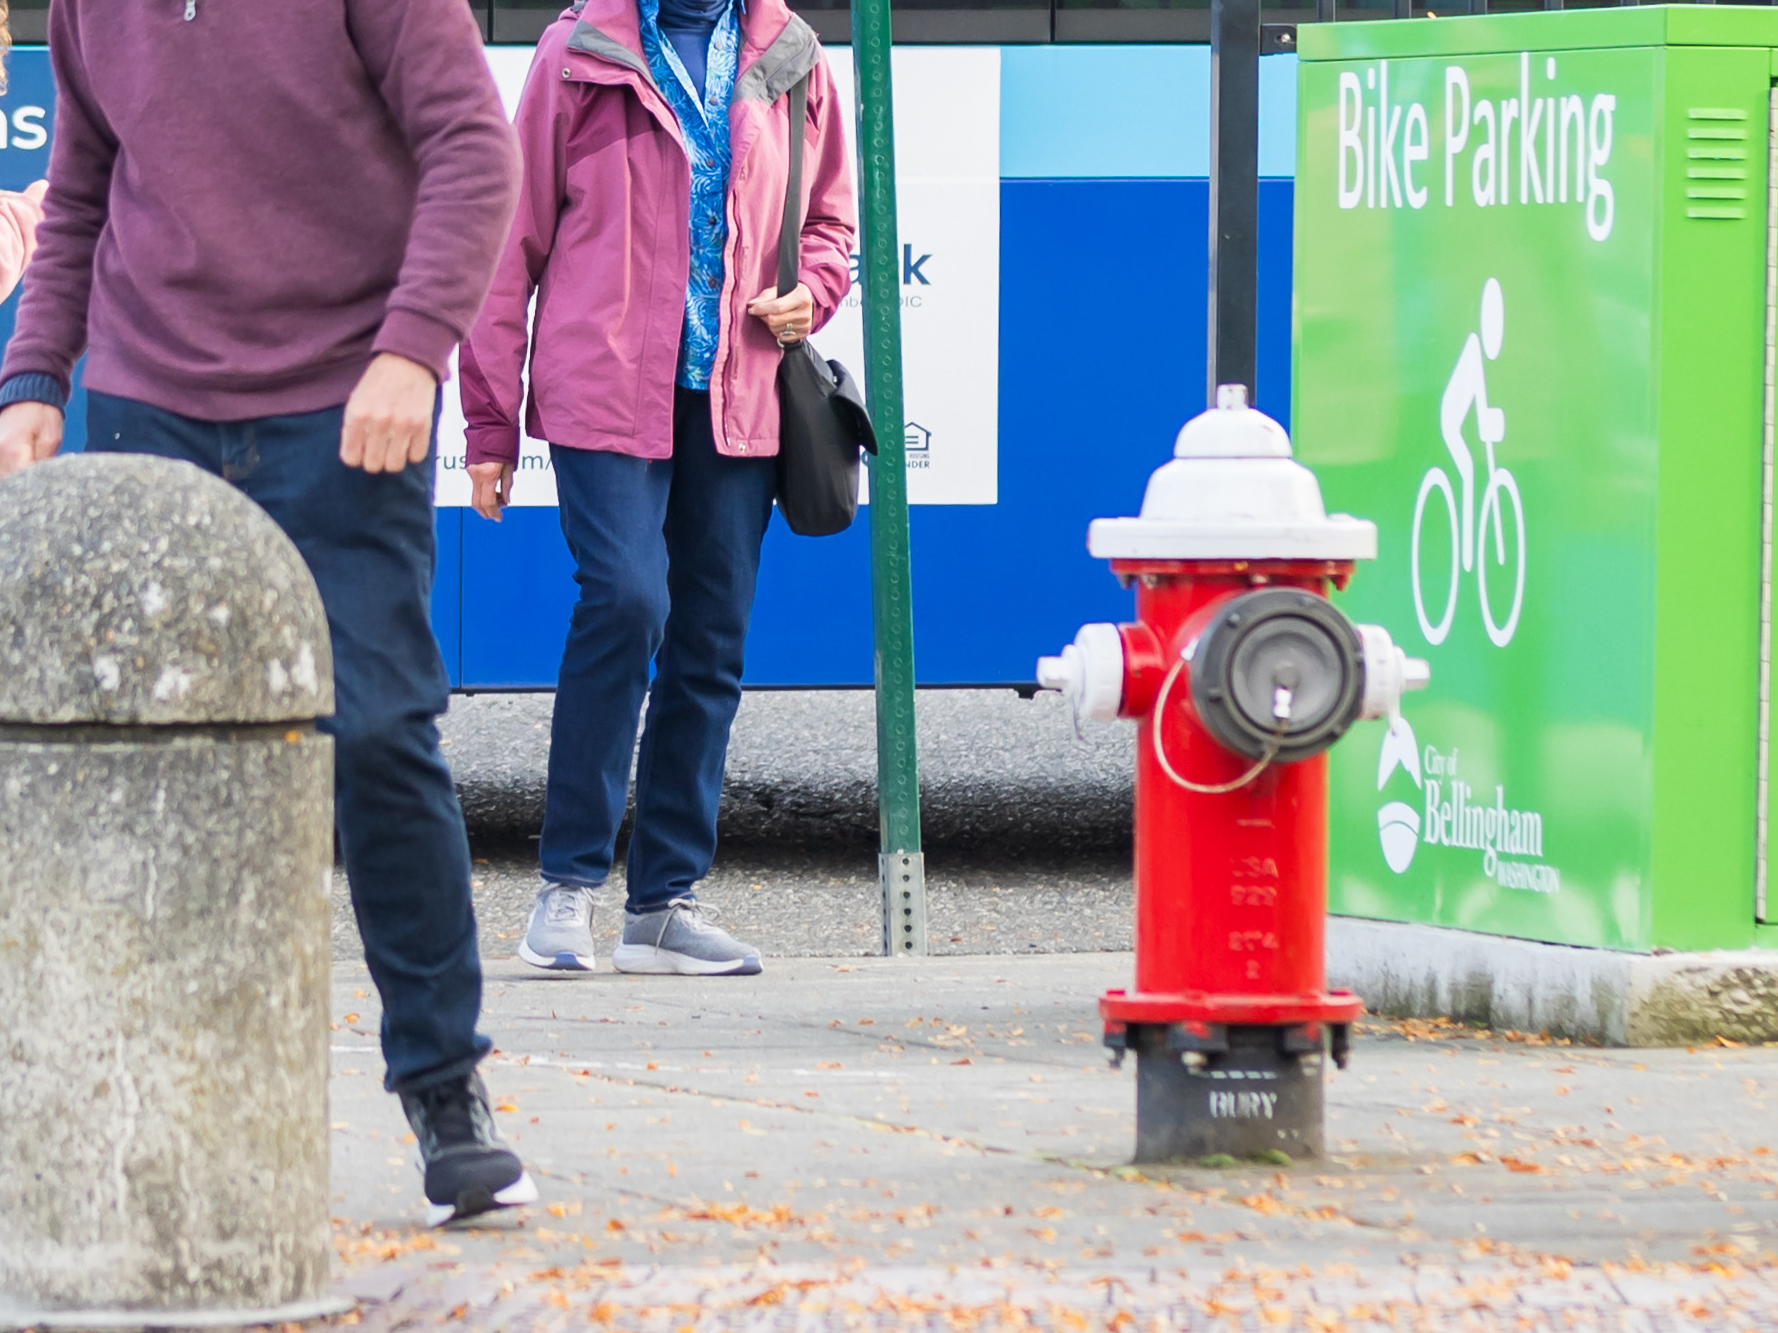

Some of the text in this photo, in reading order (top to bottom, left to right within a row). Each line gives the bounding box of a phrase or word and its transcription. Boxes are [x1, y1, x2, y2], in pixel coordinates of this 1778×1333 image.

[1338, 50, 1616, 242] Bike Parking
[1424, 744, 1459, 785] City of
[1423, 778, 1543, 878] Bellingham
